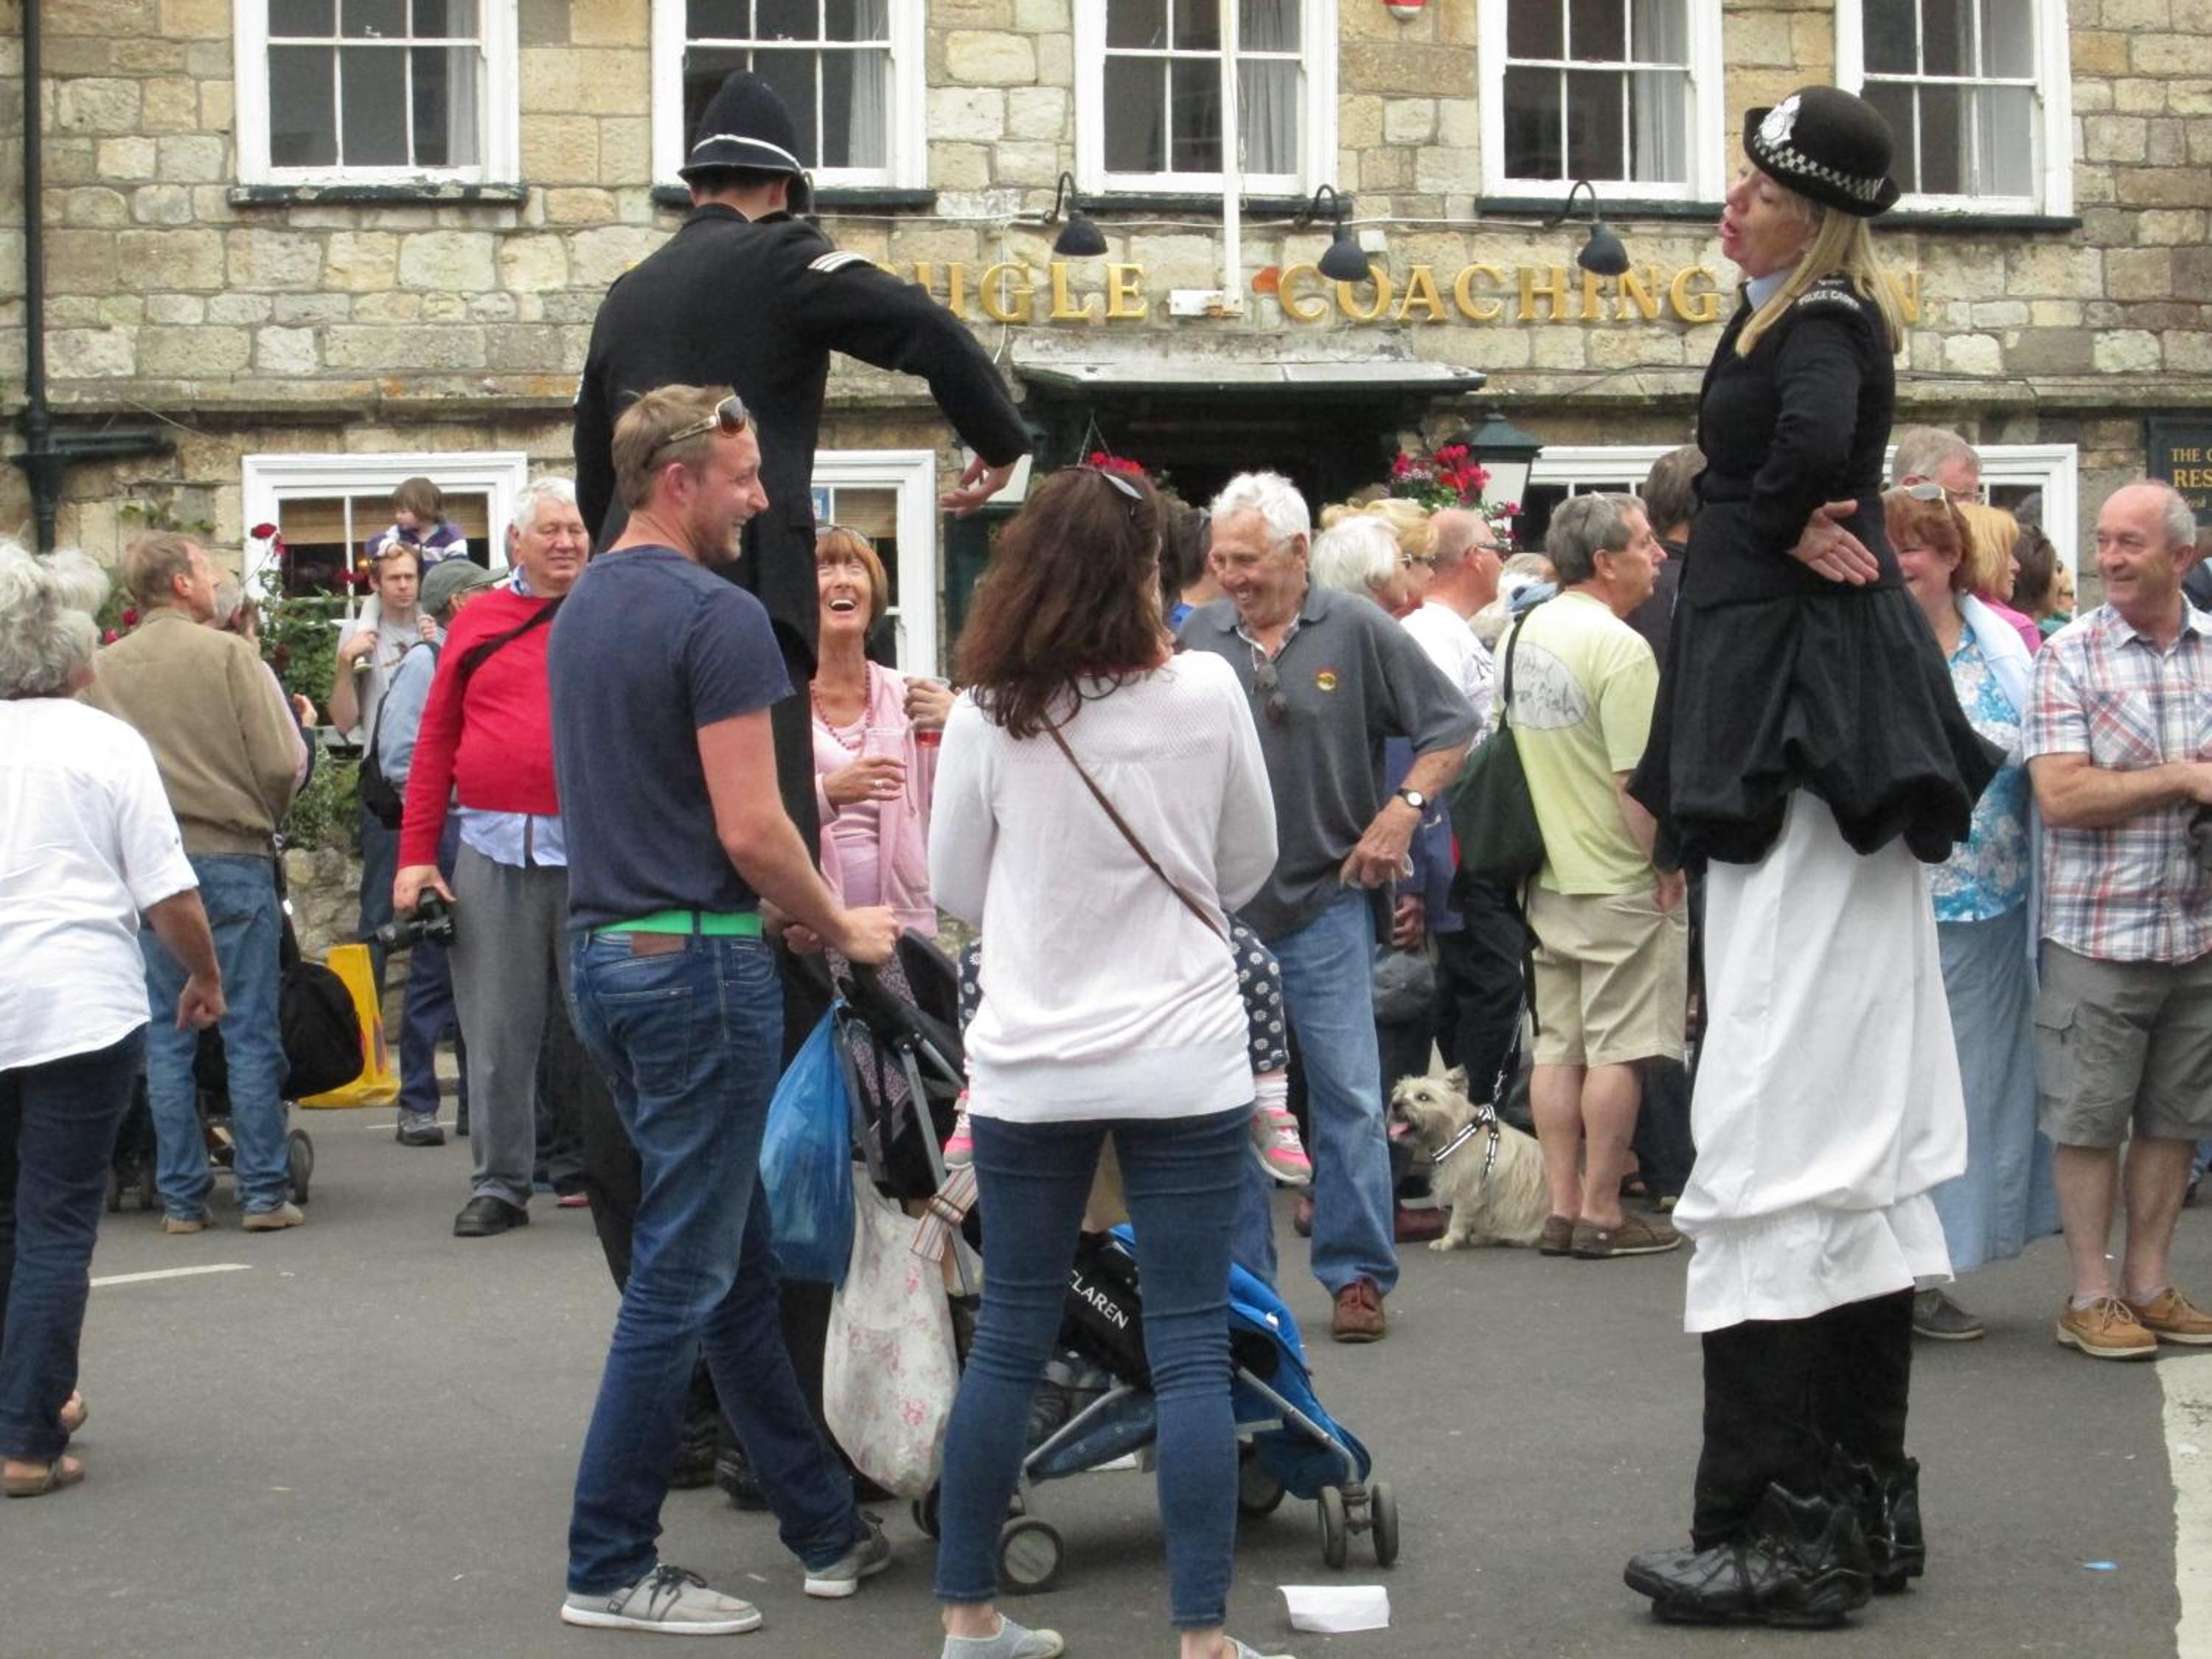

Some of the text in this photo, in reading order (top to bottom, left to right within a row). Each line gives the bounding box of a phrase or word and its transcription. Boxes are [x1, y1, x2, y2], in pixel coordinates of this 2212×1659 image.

[876, 262, 1721, 323] UGLE COACHING
[2170, 448, 2201, 462] THE
